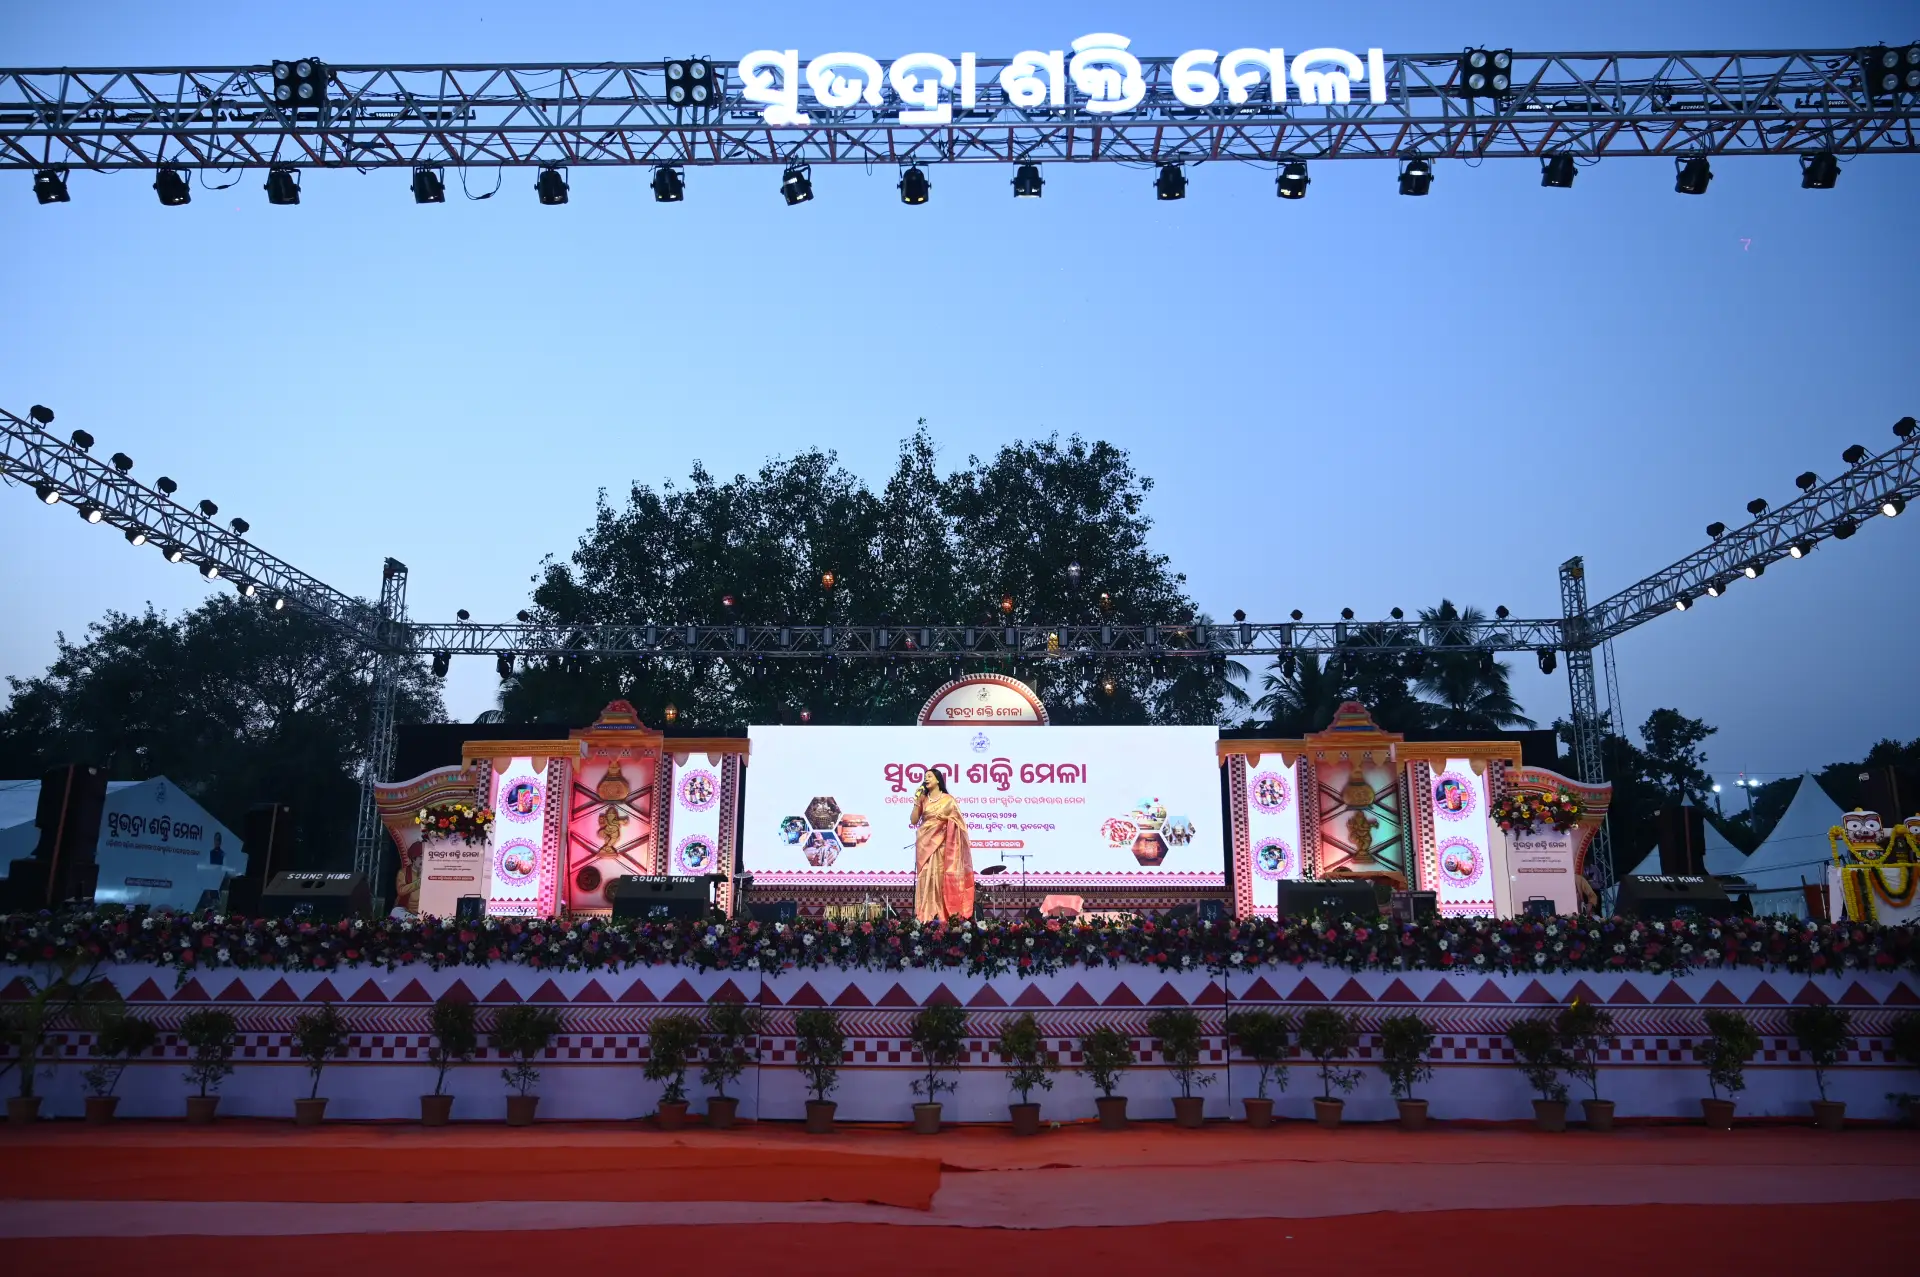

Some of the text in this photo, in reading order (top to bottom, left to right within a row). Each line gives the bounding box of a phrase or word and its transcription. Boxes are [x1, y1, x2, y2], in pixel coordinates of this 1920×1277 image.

[738, 49, 975, 126] ସୁଭଦ୍ରା
[1172, 46, 1387, 106] ମେଳା
[946, 706, 1022, 718] ସୁଭଦ୍ରା ଶକ୍ତି ମେଳା
[966, 758, 1013, 791] ଶକ୍ତି
[1020, 763, 1087, 784] ମେଳା
[108, 812, 203, 842] ସୁଭଦ୍ରା ଶକ୍ତି ମେଳା
